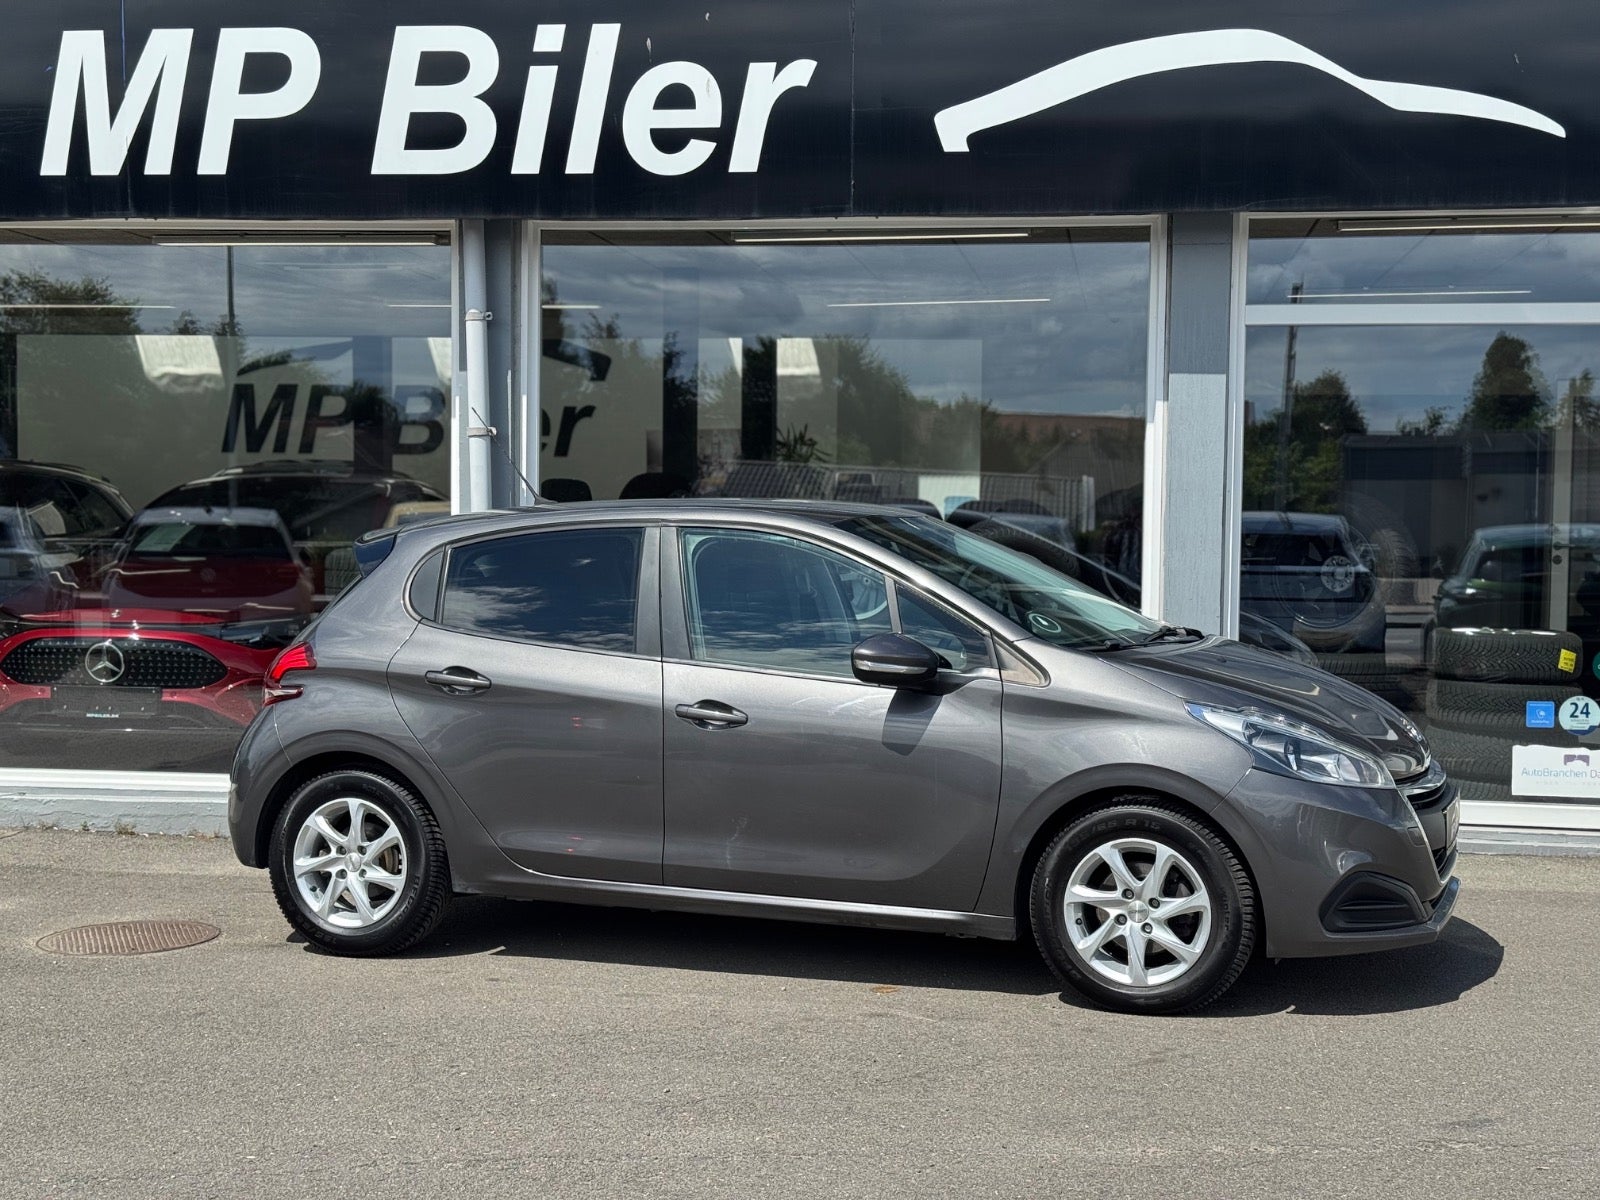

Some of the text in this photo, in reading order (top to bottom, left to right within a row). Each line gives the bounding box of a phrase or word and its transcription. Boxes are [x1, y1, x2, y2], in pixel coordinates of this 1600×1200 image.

[40, 22, 818, 177] MP Biler
[221, 383, 358, 455] MP
[1569, 702, 1591, 719] 24
[1521, 767, 1588, 779] AutoBranchen
